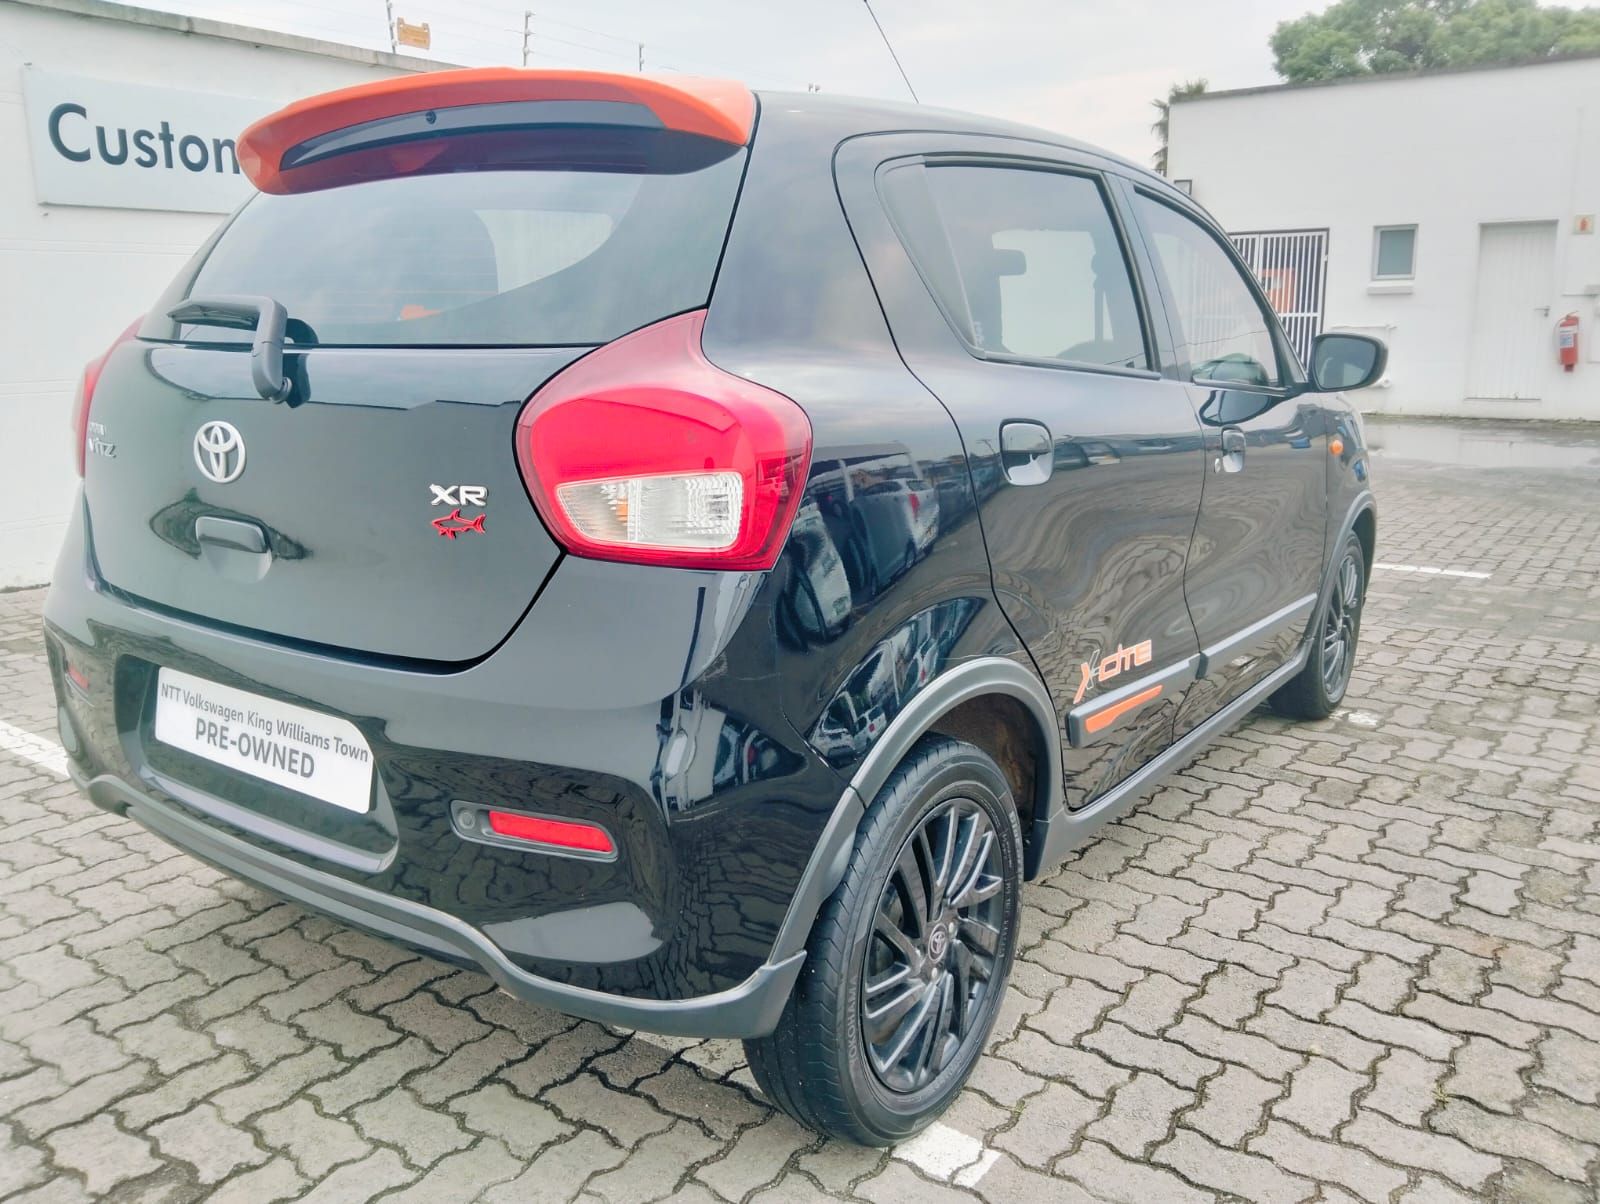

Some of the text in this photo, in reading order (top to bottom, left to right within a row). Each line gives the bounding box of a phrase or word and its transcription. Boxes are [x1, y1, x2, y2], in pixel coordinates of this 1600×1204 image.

[429, 484, 488, 506] XR
[161, 682, 369, 763] NTT Volkswagen King Williams Town
[195, 717, 315, 779] PRE-OWNED
